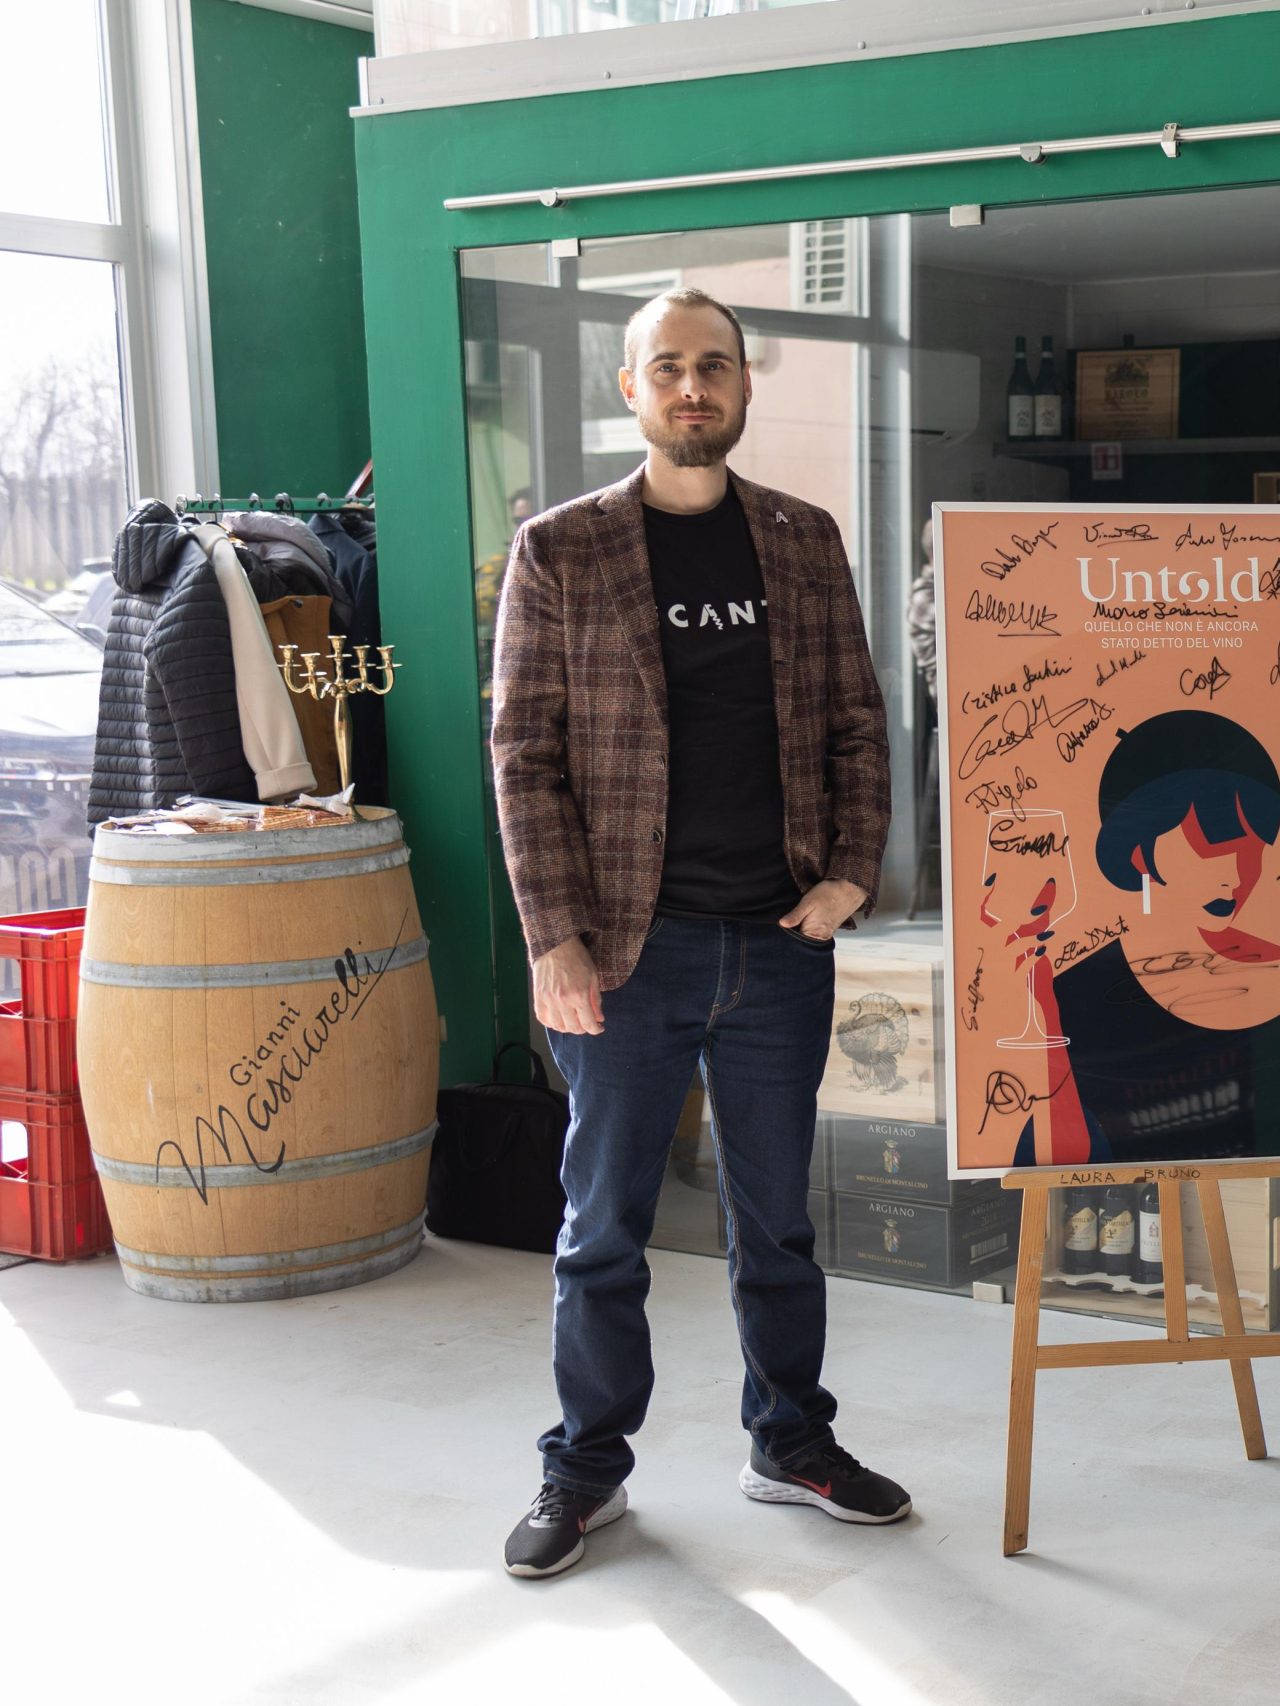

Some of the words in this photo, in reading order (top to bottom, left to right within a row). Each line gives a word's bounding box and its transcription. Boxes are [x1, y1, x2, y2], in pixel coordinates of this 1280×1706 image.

[1076, 557, 1264, 602] Untold
[668, 600, 767, 630] CAN
[1084, 621, 1133, 633] QUELLO
[1136, 621, 1162, 632] CHE
[1165, 621, 1193, 632] NON
[1196, 618, 1205, 631] È
[1207, 621, 1259, 632] ANCORA
[1101, 638, 1140, 649] STATO
[1143, 638, 1183, 649] DETTO
[1186, 638, 1210, 648] DEL
[1213, 638, 1243, 648] VINO
[229, 1000, 301, 1087] Gianni
[868, 1124, 916, 1138] ARGIANO
[1060, 1171, 1116, 1184] LAURA
[1144, 1168, 1200, 1180] BRUNO
[869, 1203, 915, 1217] ARGIANO
